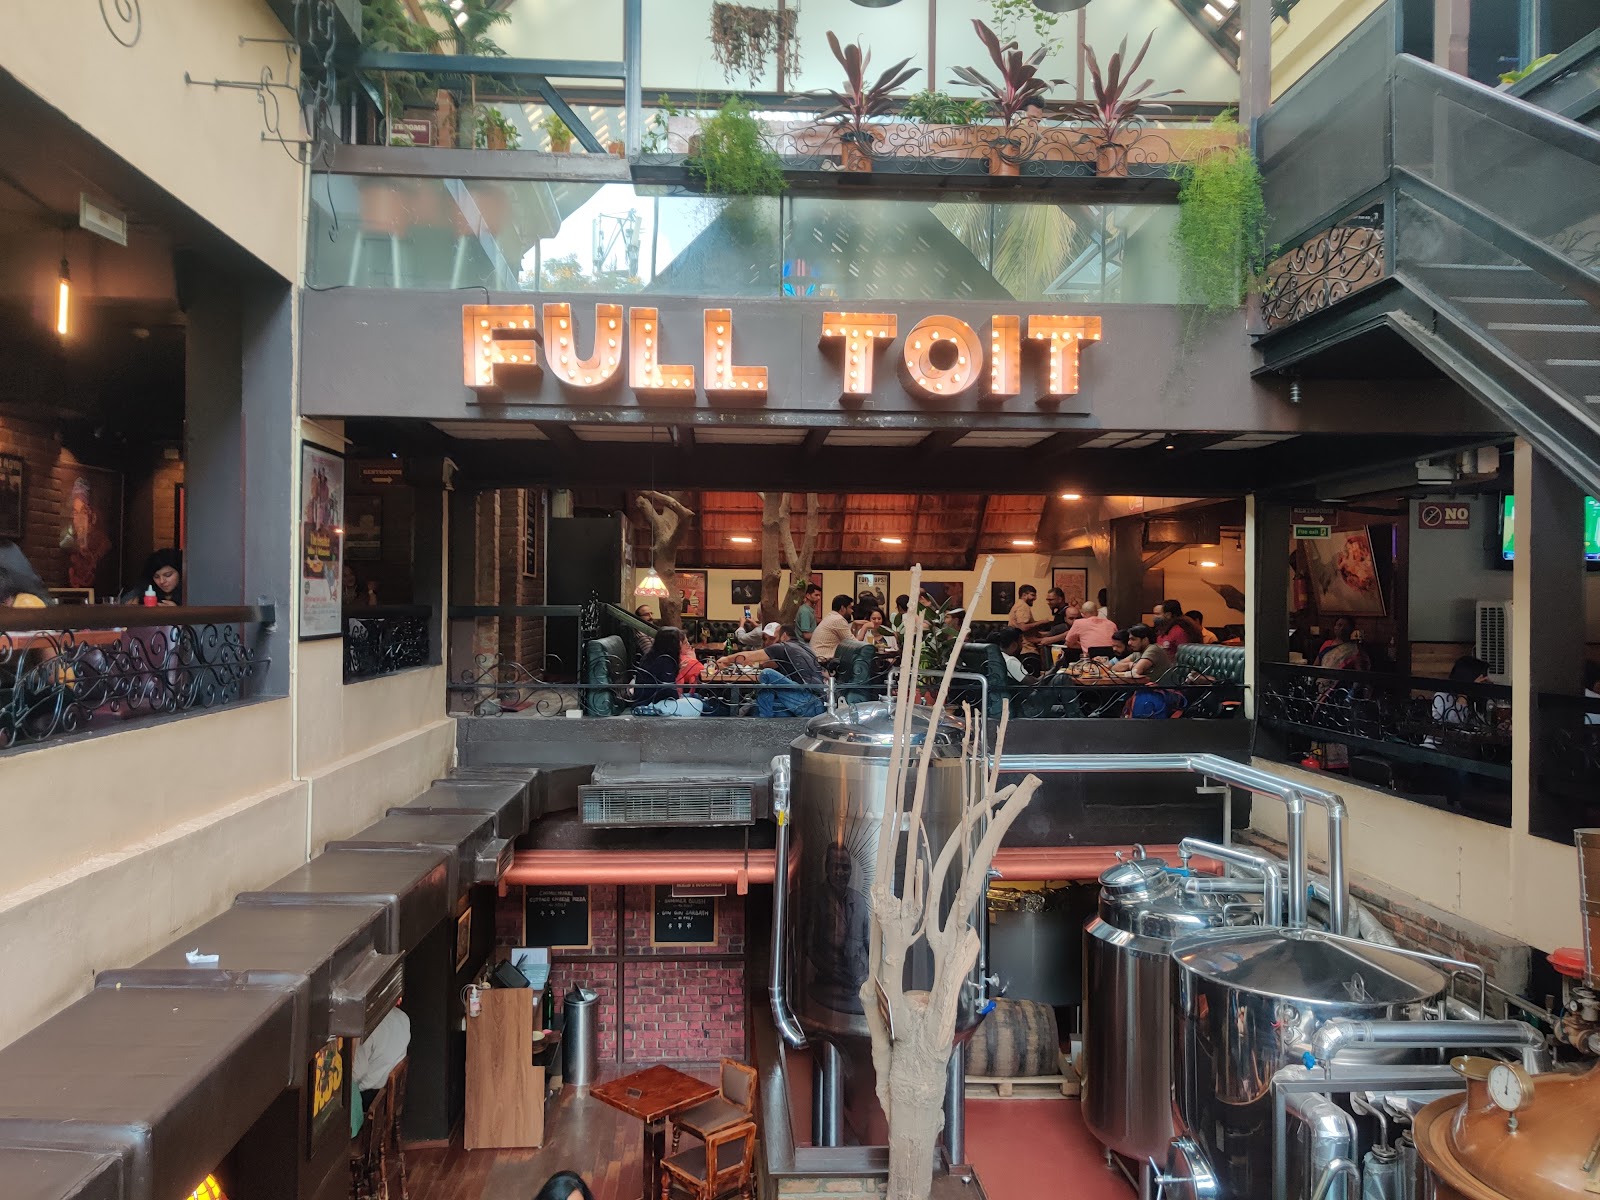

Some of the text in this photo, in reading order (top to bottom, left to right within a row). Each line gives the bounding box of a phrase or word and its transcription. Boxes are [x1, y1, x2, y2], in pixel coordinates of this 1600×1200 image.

[462, 302, 1102, 396] FULL TOIT
[1444, 507, 1469, 520] NO
